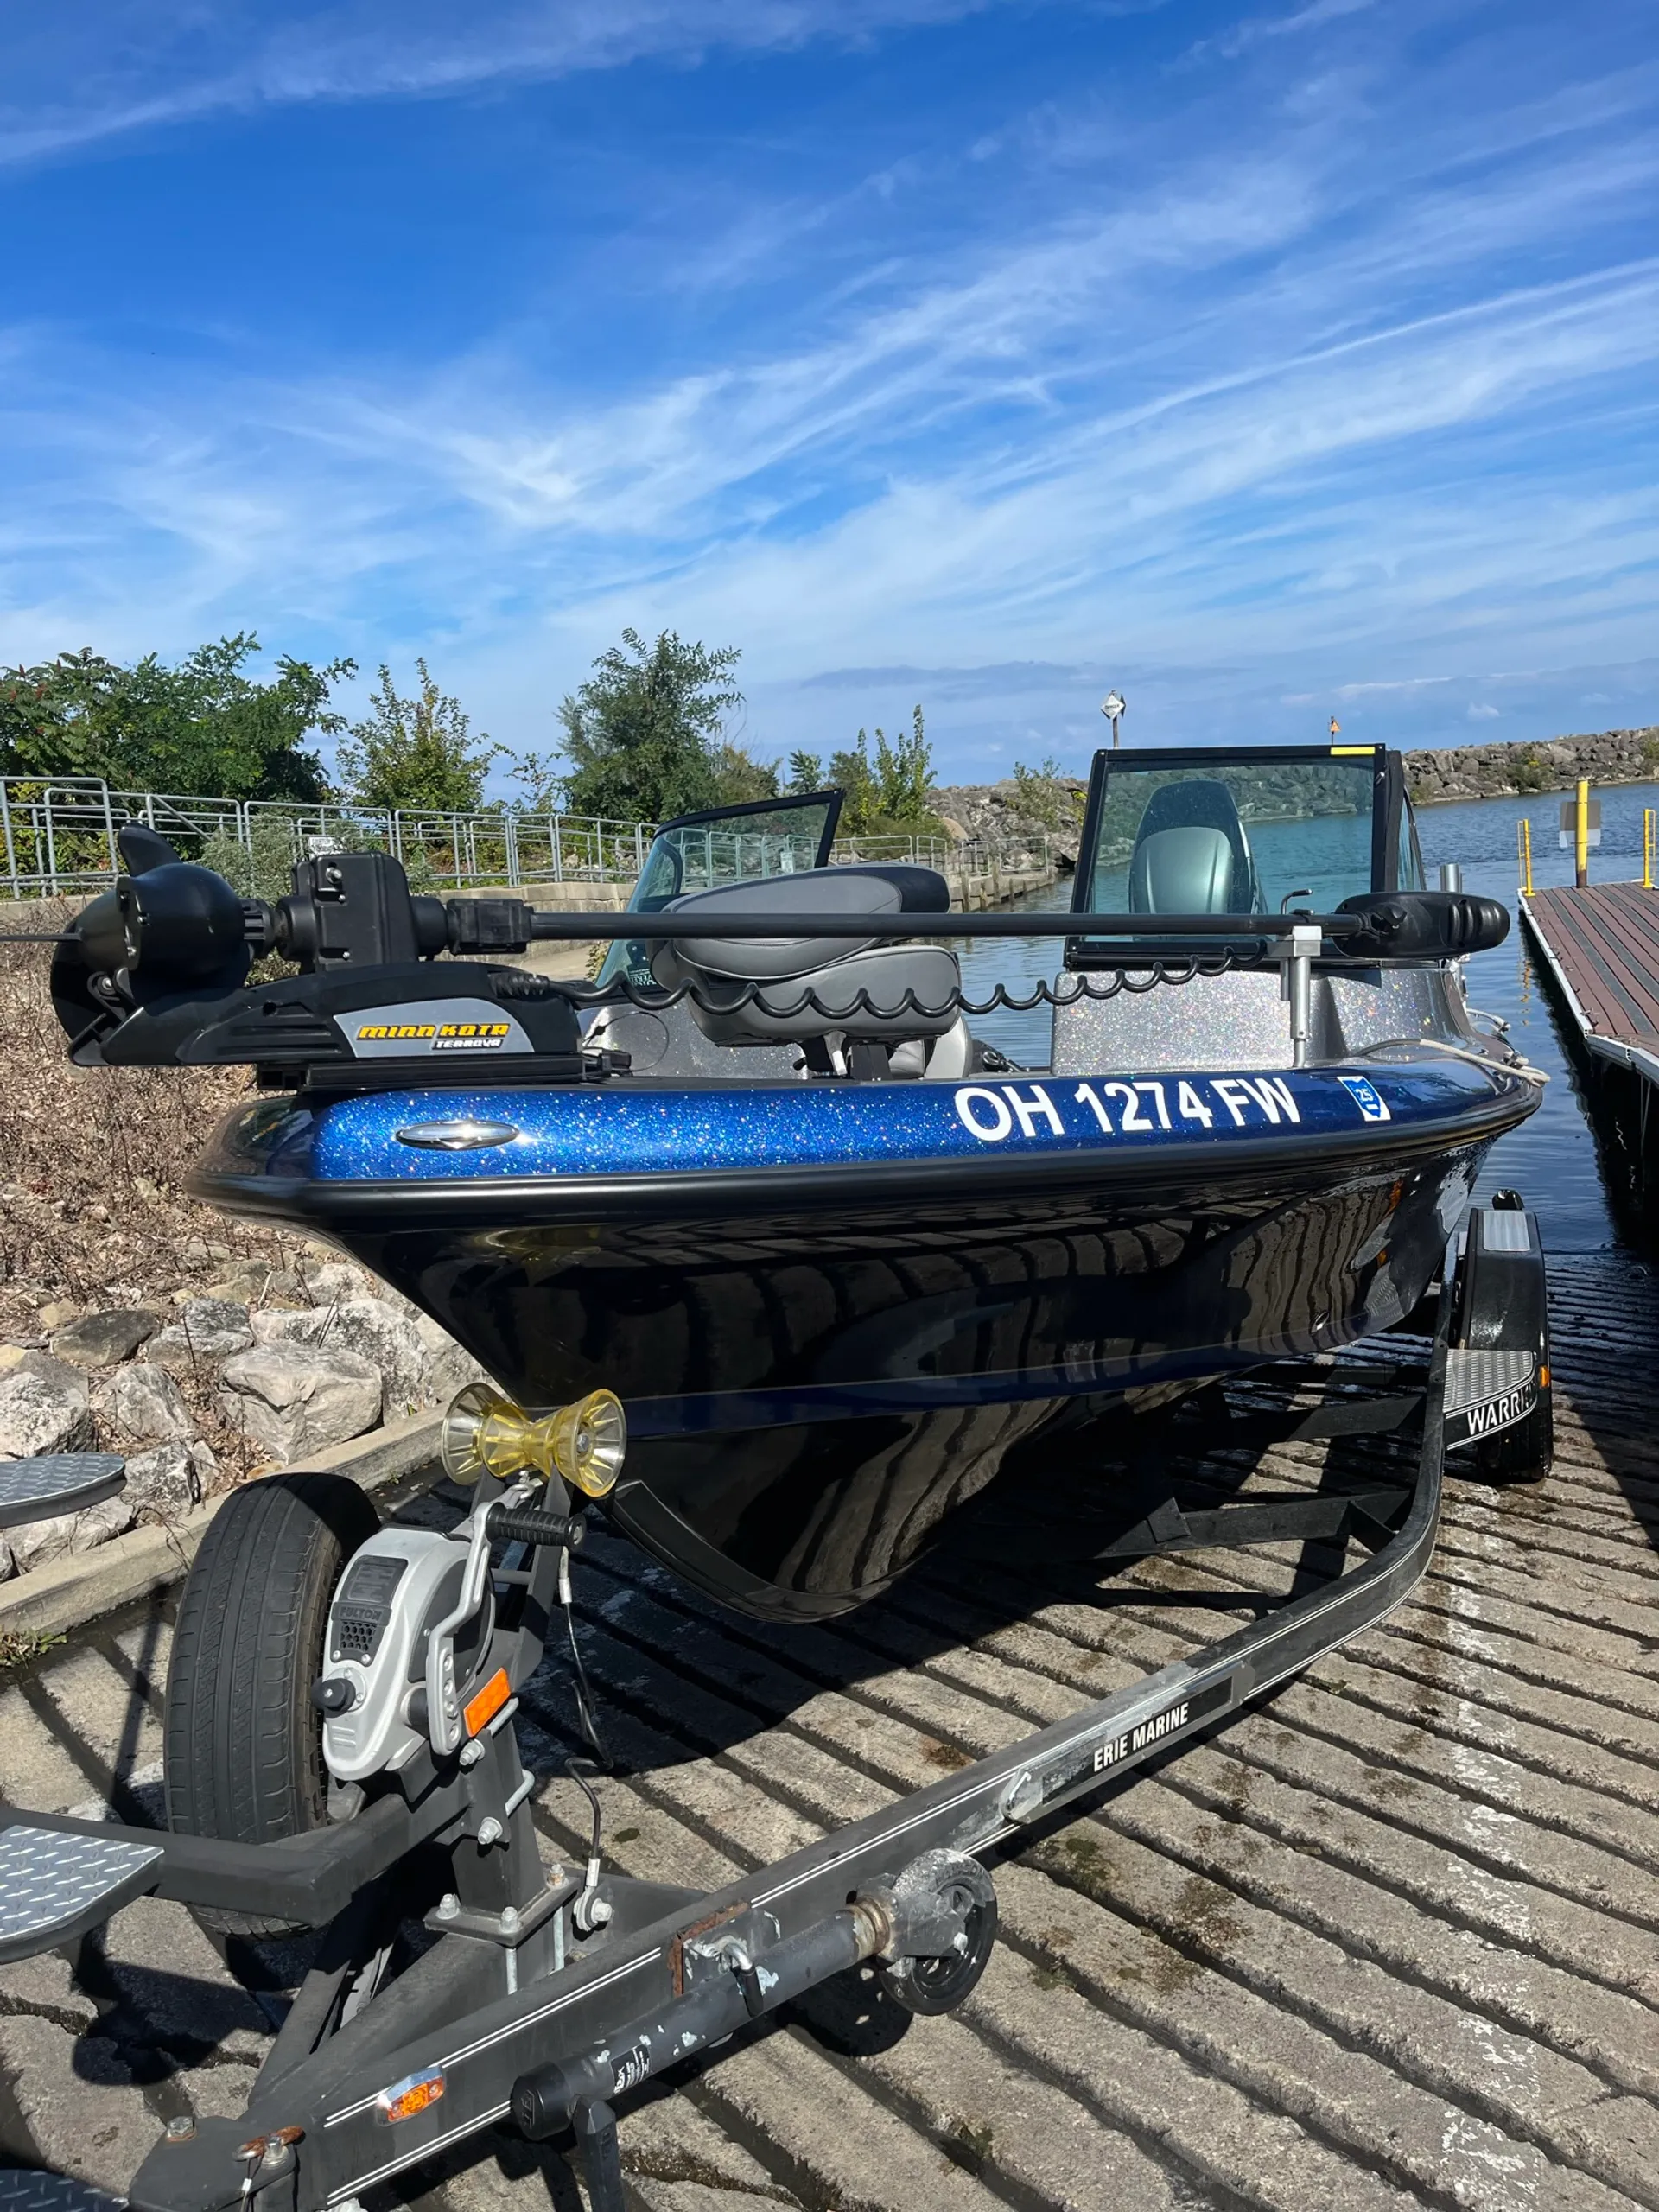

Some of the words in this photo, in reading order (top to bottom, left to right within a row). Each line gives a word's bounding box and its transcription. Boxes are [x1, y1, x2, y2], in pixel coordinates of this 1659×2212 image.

[437, 1023, 511, 1038] KOTA
[434, 1039, 503, 1050] TERROVA
[1355, 1088, 1374, 1102] 25
[955, 1084, 1065, 1141] OH
[1074, 1081, 1213, 1133] 1274
[1209, 1077, 1301, 1127] FW
[340, 1606, 382, 1621] FULTON
[1093, 1734, 1128, 1772] ERIE
[1133, 1702, 1189, 1751] MARINE
